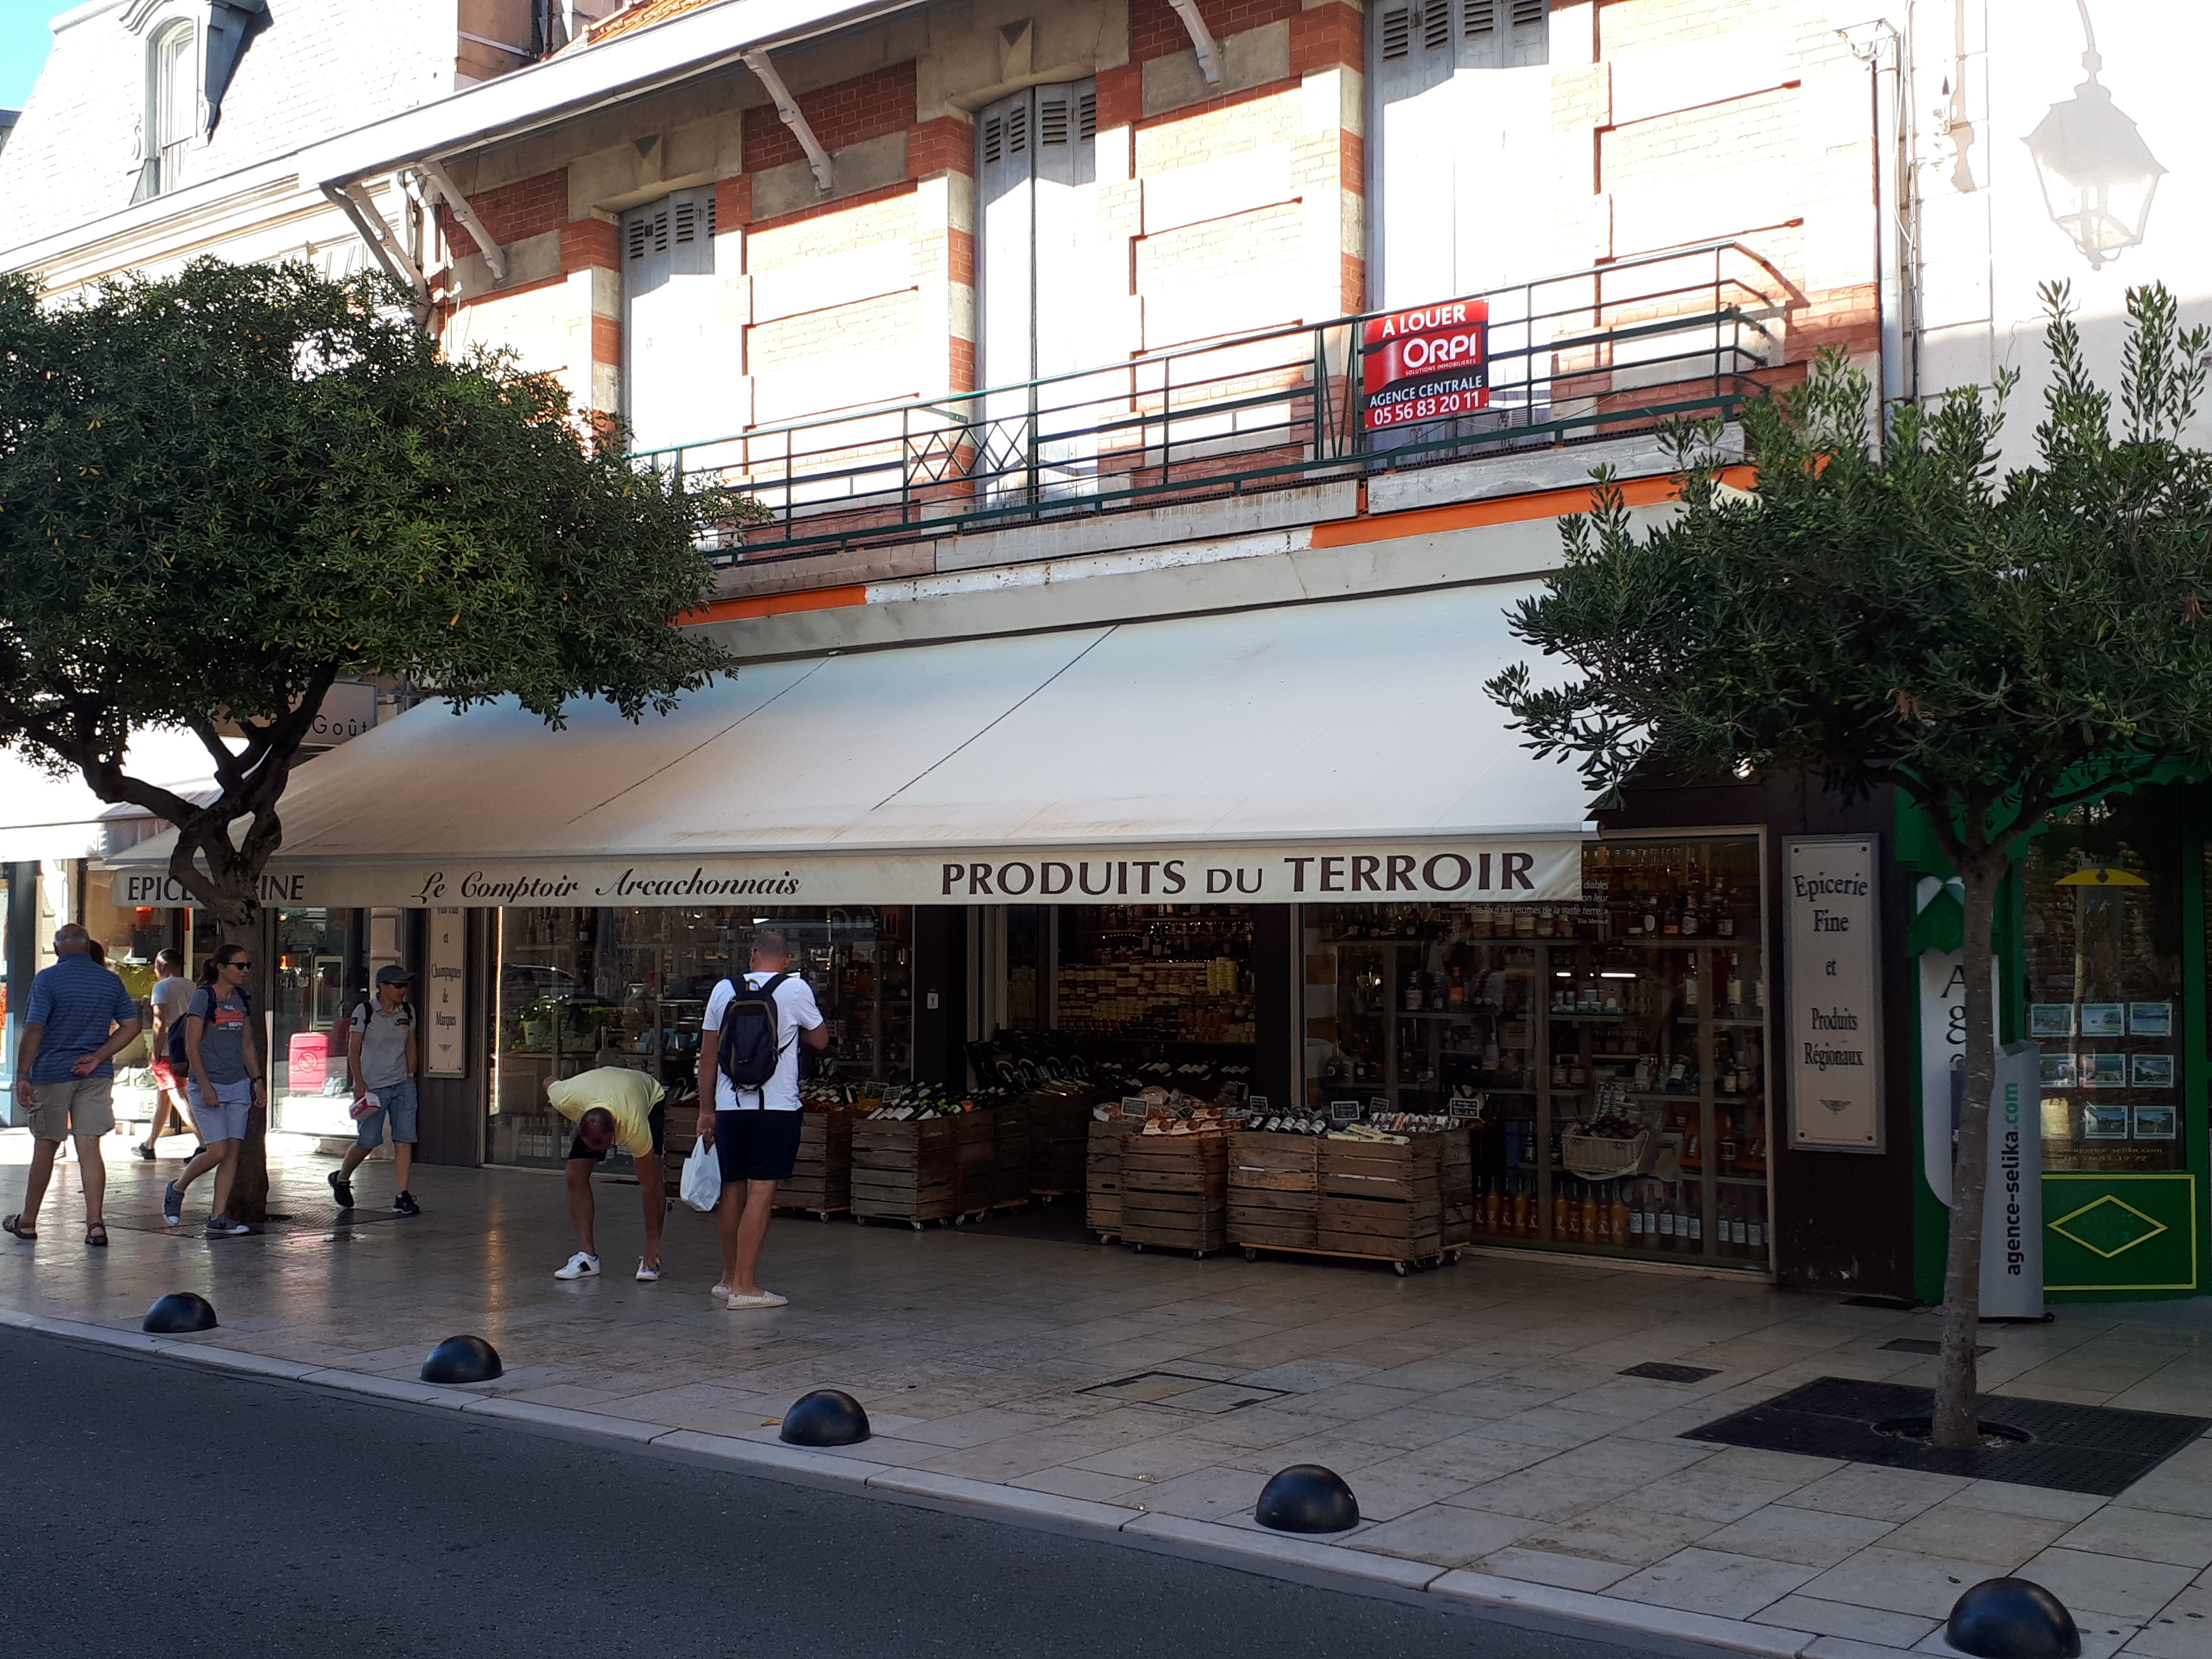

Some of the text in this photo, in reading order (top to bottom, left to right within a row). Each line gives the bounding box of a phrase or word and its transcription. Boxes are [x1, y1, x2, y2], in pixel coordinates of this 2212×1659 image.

[1399, 304, 1466, 333] LOUER
[1403, 333, 1477, 368] ORPI
[1405, 365, 1436, 376] SOLUTIONS
[1370, 375, 1483, 408] AGENCE CENTRALE
[1374, 390, 1479, 426] 05 56 83 20 11
[411, 867, 804, 904] Le Comptoir Arcachonnais
[942, 852, 1536, 896] PRODUITS DU TERROIR
[1793, 872, 1868, 901] Epicerie
[254, 875, 304, 901] INE
[1593, 893, 1610, 903] leur
[1813, 909, 1849, 932] Fine
[432, 963, 462, 981] Champagnes
[1826, 959, 1837, 976] et
[443, 988, 449, 1003] de
[436, 1011, 456, 1030] Marques
[1811, 1007, 1858, 1030] Produits
[1804, 1042, 1864, 1071] Régionaux
[2001, 1082, 2024, 1276] agence-selika.com
